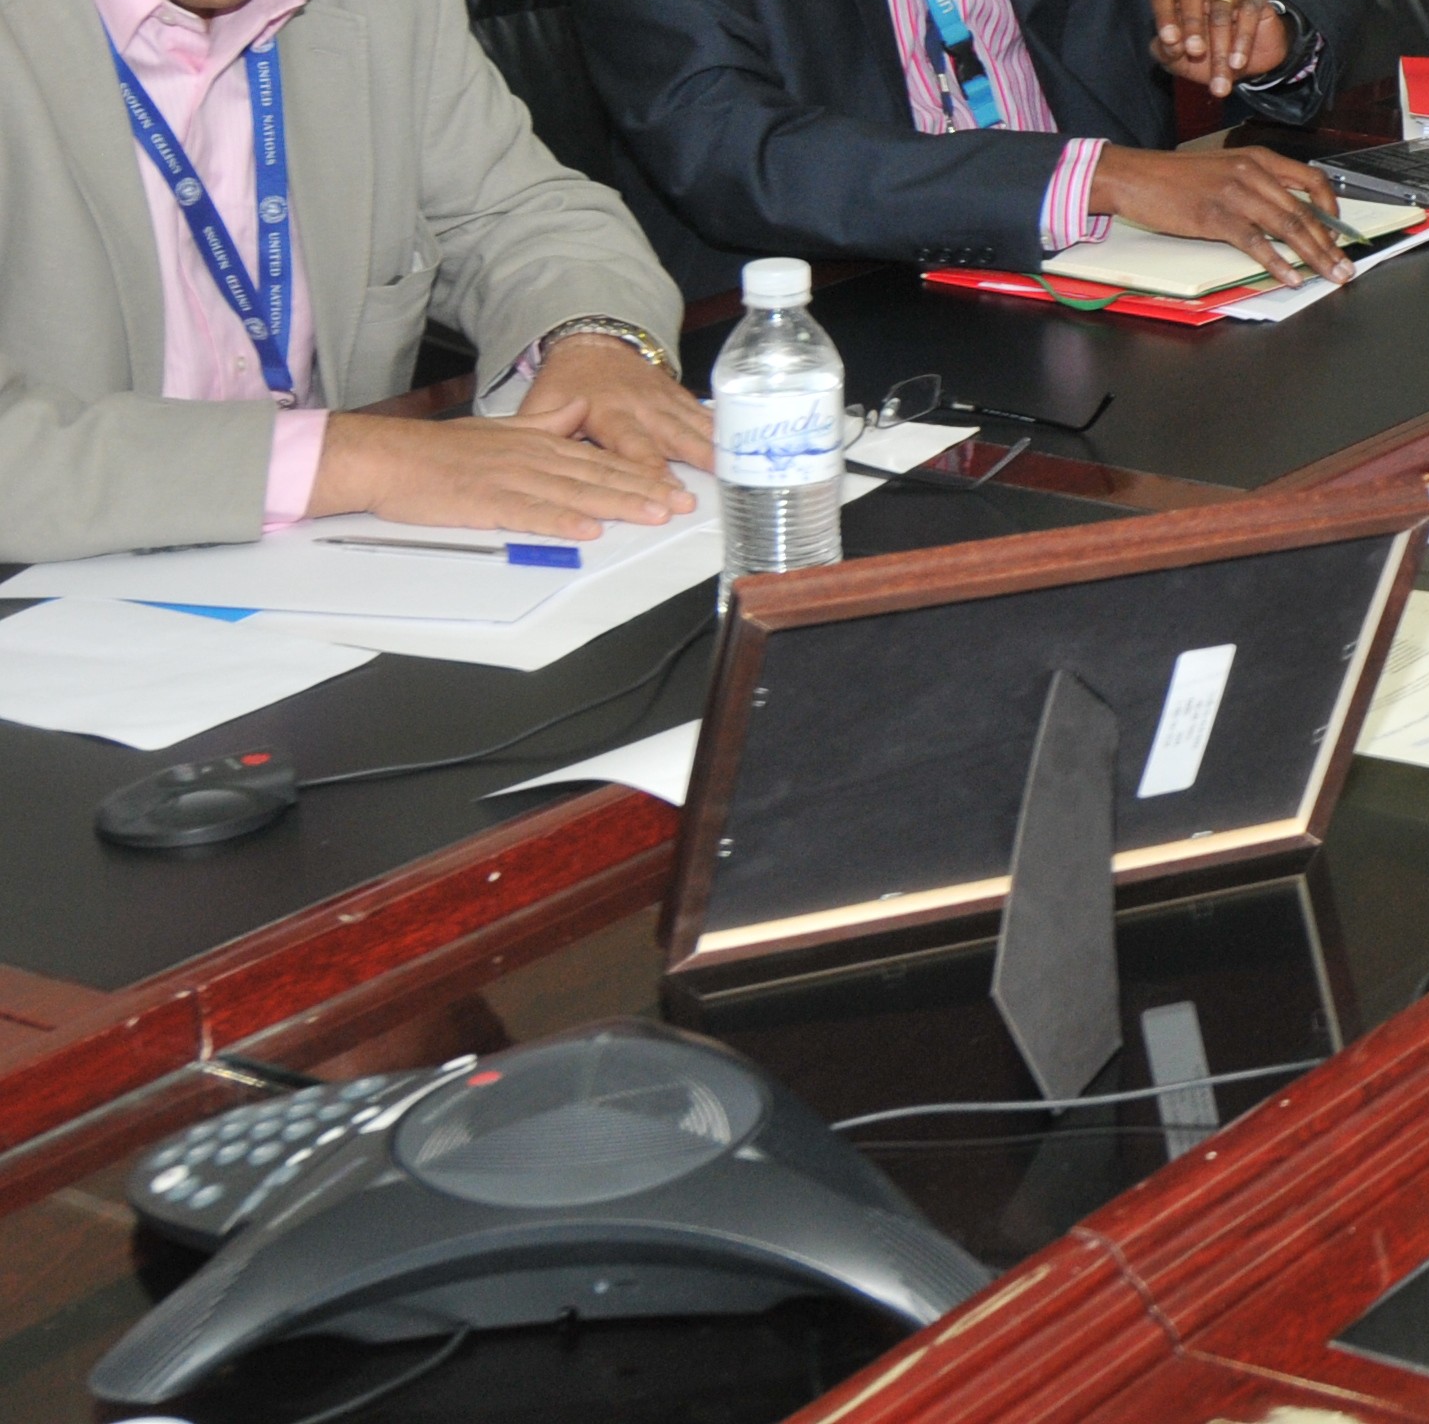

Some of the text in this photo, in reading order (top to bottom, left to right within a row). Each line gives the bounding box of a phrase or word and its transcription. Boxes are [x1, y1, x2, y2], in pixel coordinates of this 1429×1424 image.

[120, 82, 182, 175] UNITED NATIONS
[257, 61, 277, 166] UNITED NATIONS
[203, 226, 253, 312] UNITED NATIONS
[268, 232, 282, 335] UNITED NATIONS
